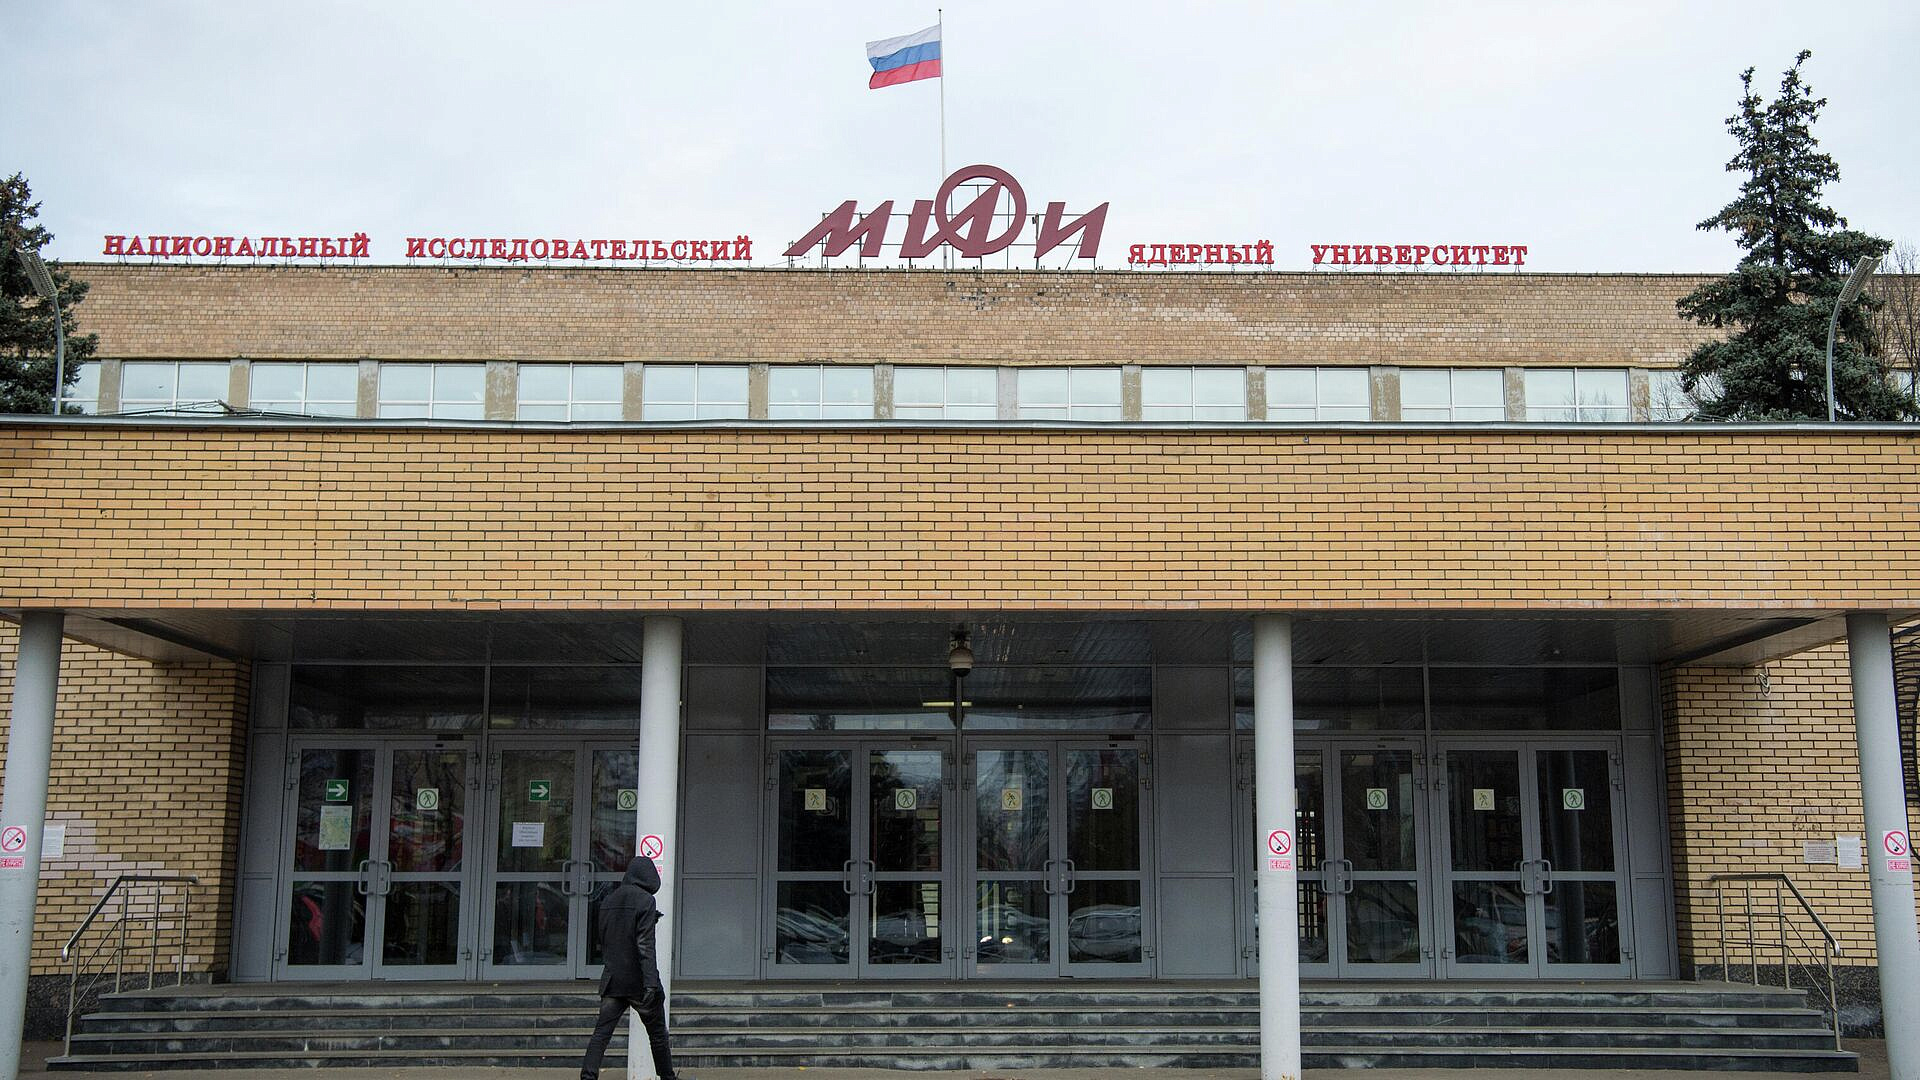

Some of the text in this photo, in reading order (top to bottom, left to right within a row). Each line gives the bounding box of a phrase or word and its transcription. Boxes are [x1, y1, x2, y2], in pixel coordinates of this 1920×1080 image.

[103, 232, 1528, 267] НАЦИОНАЛЬНЫЙ ИССЛЕДОВАТЕЛЬСКИЙ ЯДЕРНЫЙ УНИВЕРСИТЕТ
